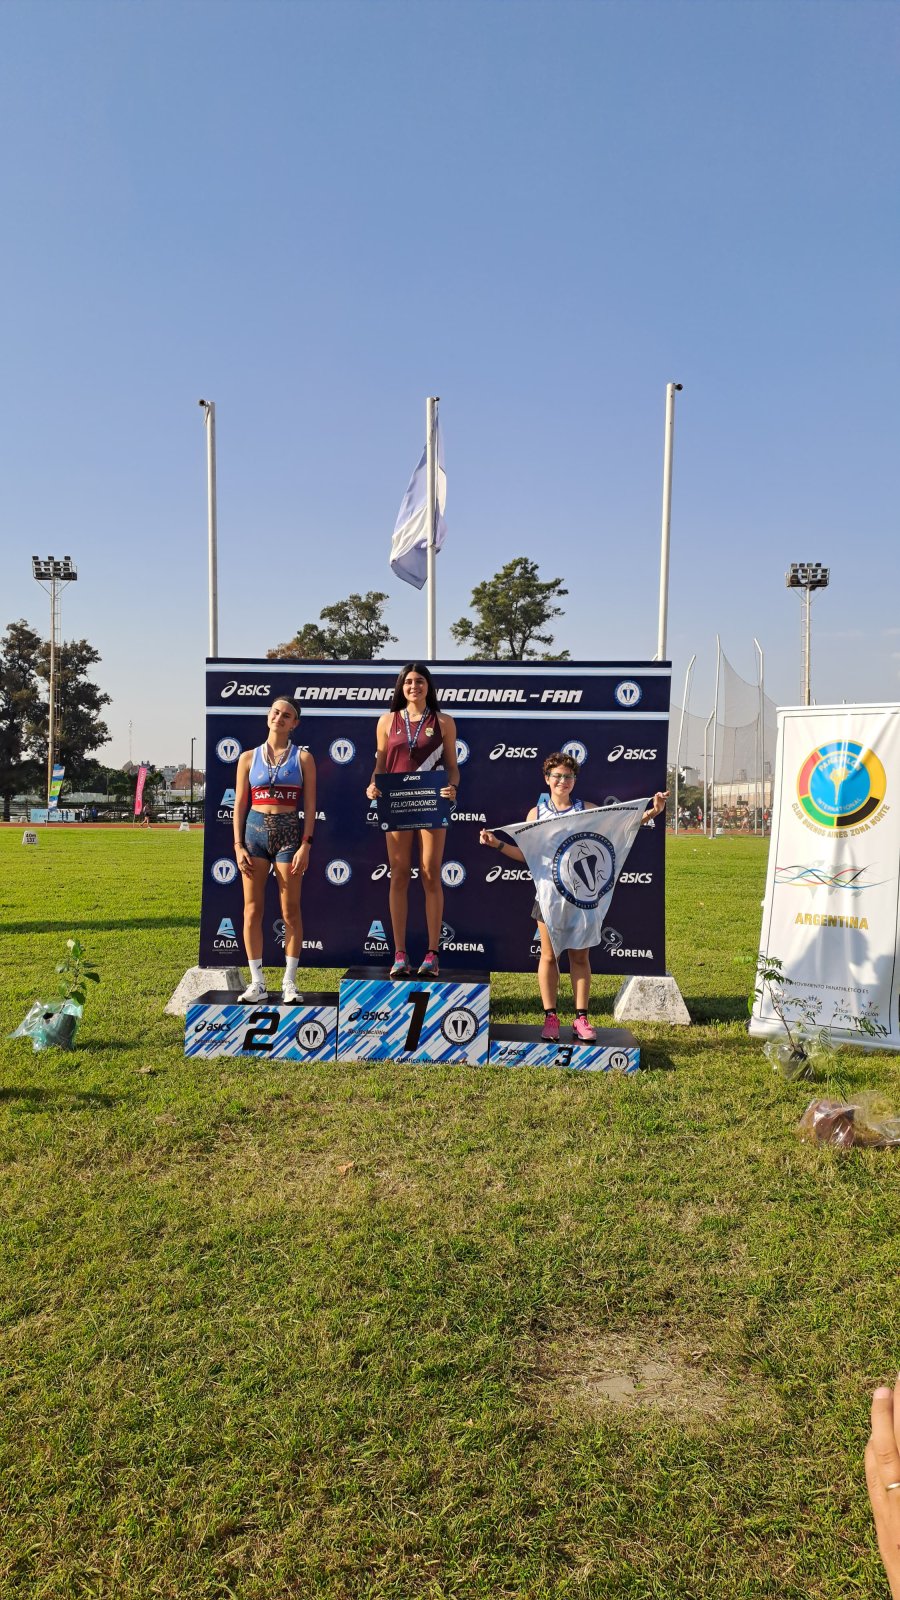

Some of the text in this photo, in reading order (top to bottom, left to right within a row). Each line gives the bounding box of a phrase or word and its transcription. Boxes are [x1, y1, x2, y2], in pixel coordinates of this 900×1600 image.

[237, 684, 271, 697] asics
[293, 686, 396, 701] CAMPEONA
[505, 746, 538, 758] asics
[623, 748, 657, 760] asics
[287, 791, 297, 800] FE
[827, 830, 849, 839] AIRES
[850, 823, 871, 837] ZONA
[870, 804, 890, 827] NORTE
[619, 872, 653, 884] asics
[795, 912, 869, 930] ARGENTINA
[213, 939, 239, 948] CADA
[364, 942, 390, 951] CADA
[442, 943, 485, 953] FORENA
[610, 948, 654, 959] FORENA
[361, 1010, 390, 1021] asics
[404, 991, 431, 1052] 1
[242, 1011, 281, 1051] 2
[554, 1046, 574, 1066] 3
